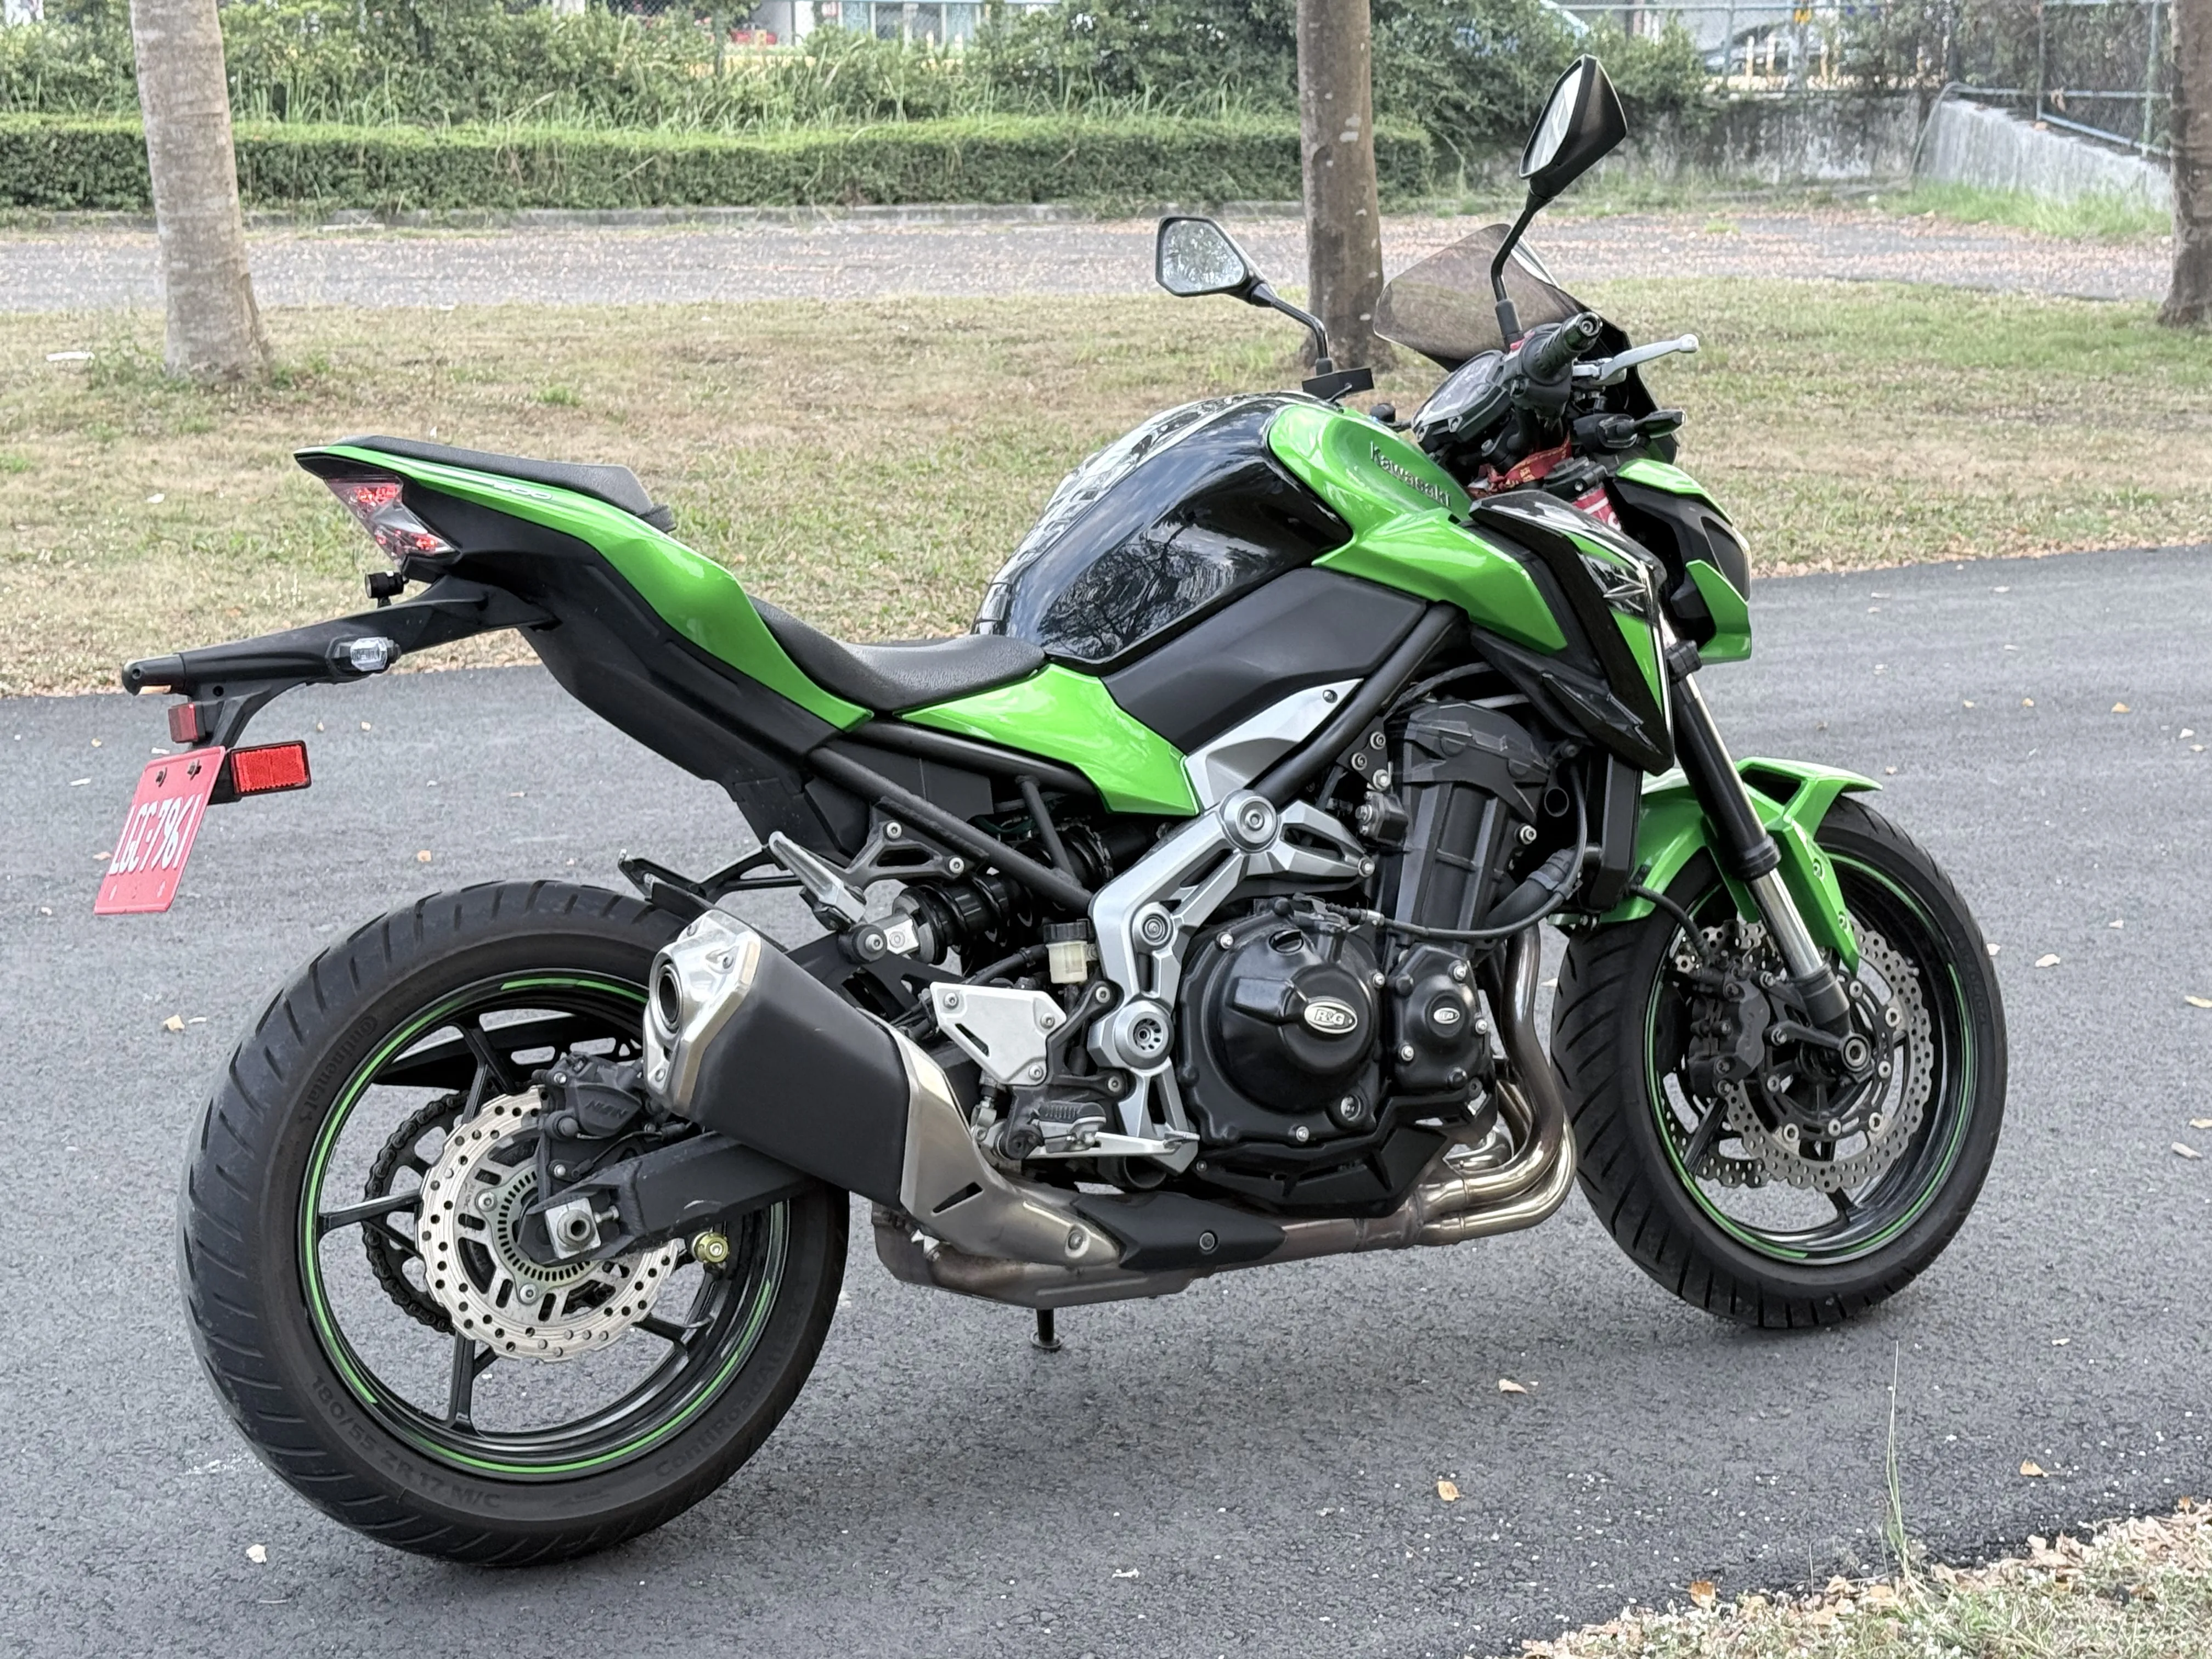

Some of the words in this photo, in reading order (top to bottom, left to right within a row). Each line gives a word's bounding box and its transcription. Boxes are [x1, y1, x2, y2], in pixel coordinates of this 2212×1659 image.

[1370, 441, 1451, 508] Kawasaki
[1316, 1009, 1345, 1025] R&G
[305, 1014, 380, 1110] Continental
[312, 1375, 377, 1451] 180/55
